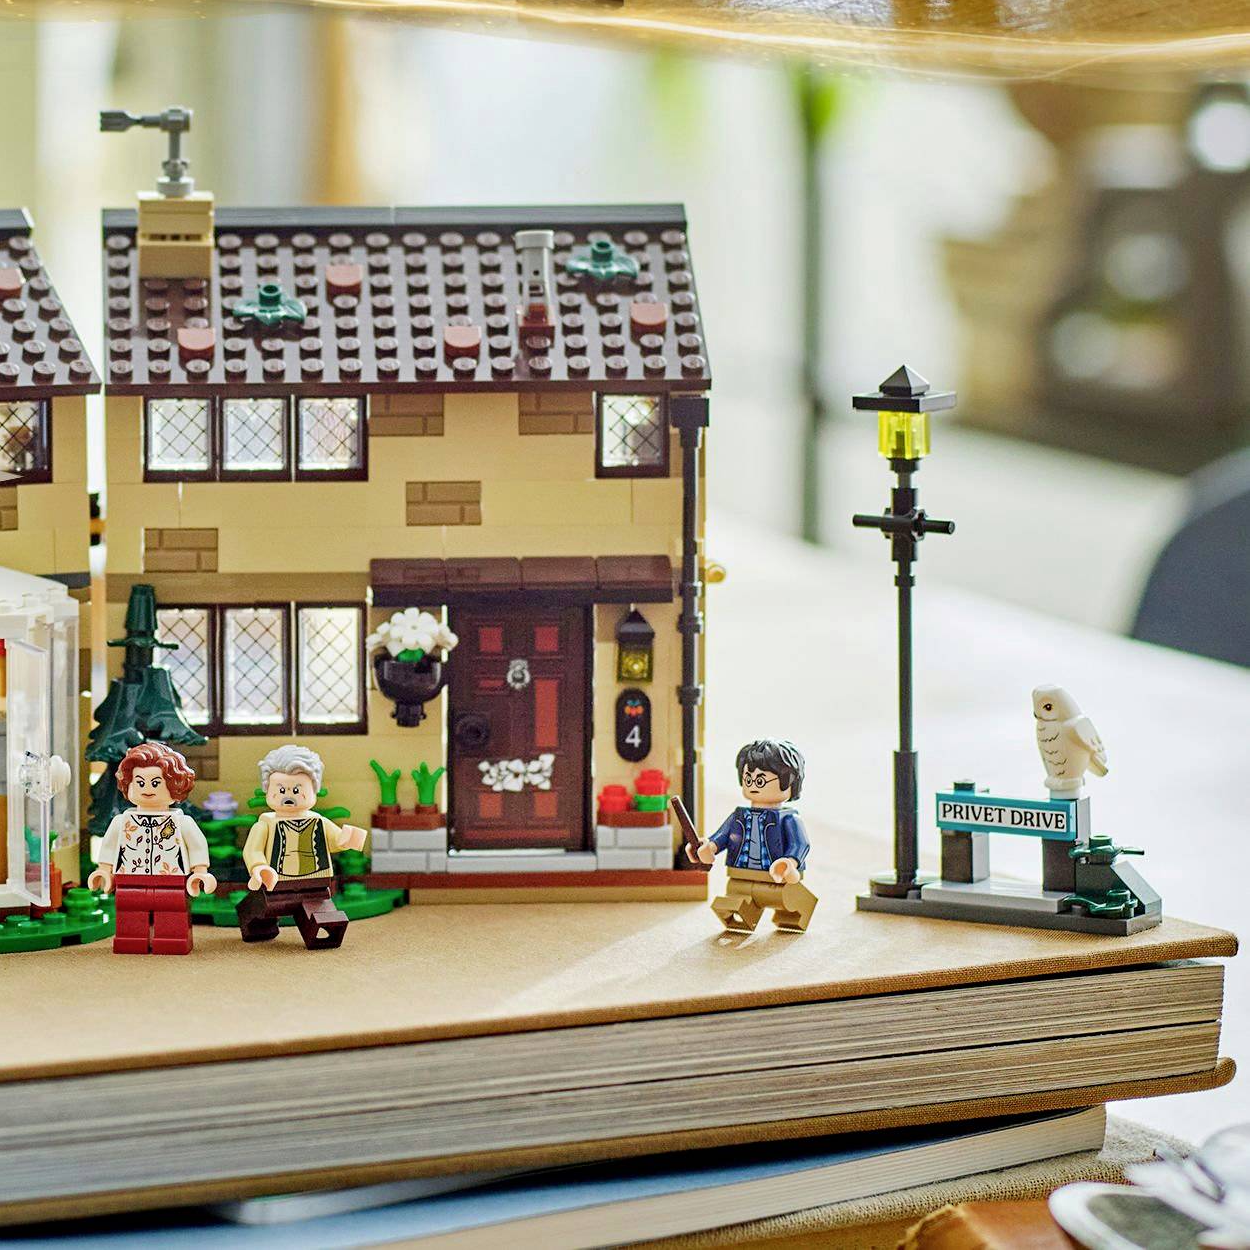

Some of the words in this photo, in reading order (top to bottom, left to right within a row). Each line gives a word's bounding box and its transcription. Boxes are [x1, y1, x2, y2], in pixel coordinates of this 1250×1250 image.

[624, 725, 642, 748] 4
[942, 803, 1006, 823] PRIVET
[1010, 810, 1065, 829] DRIVE
